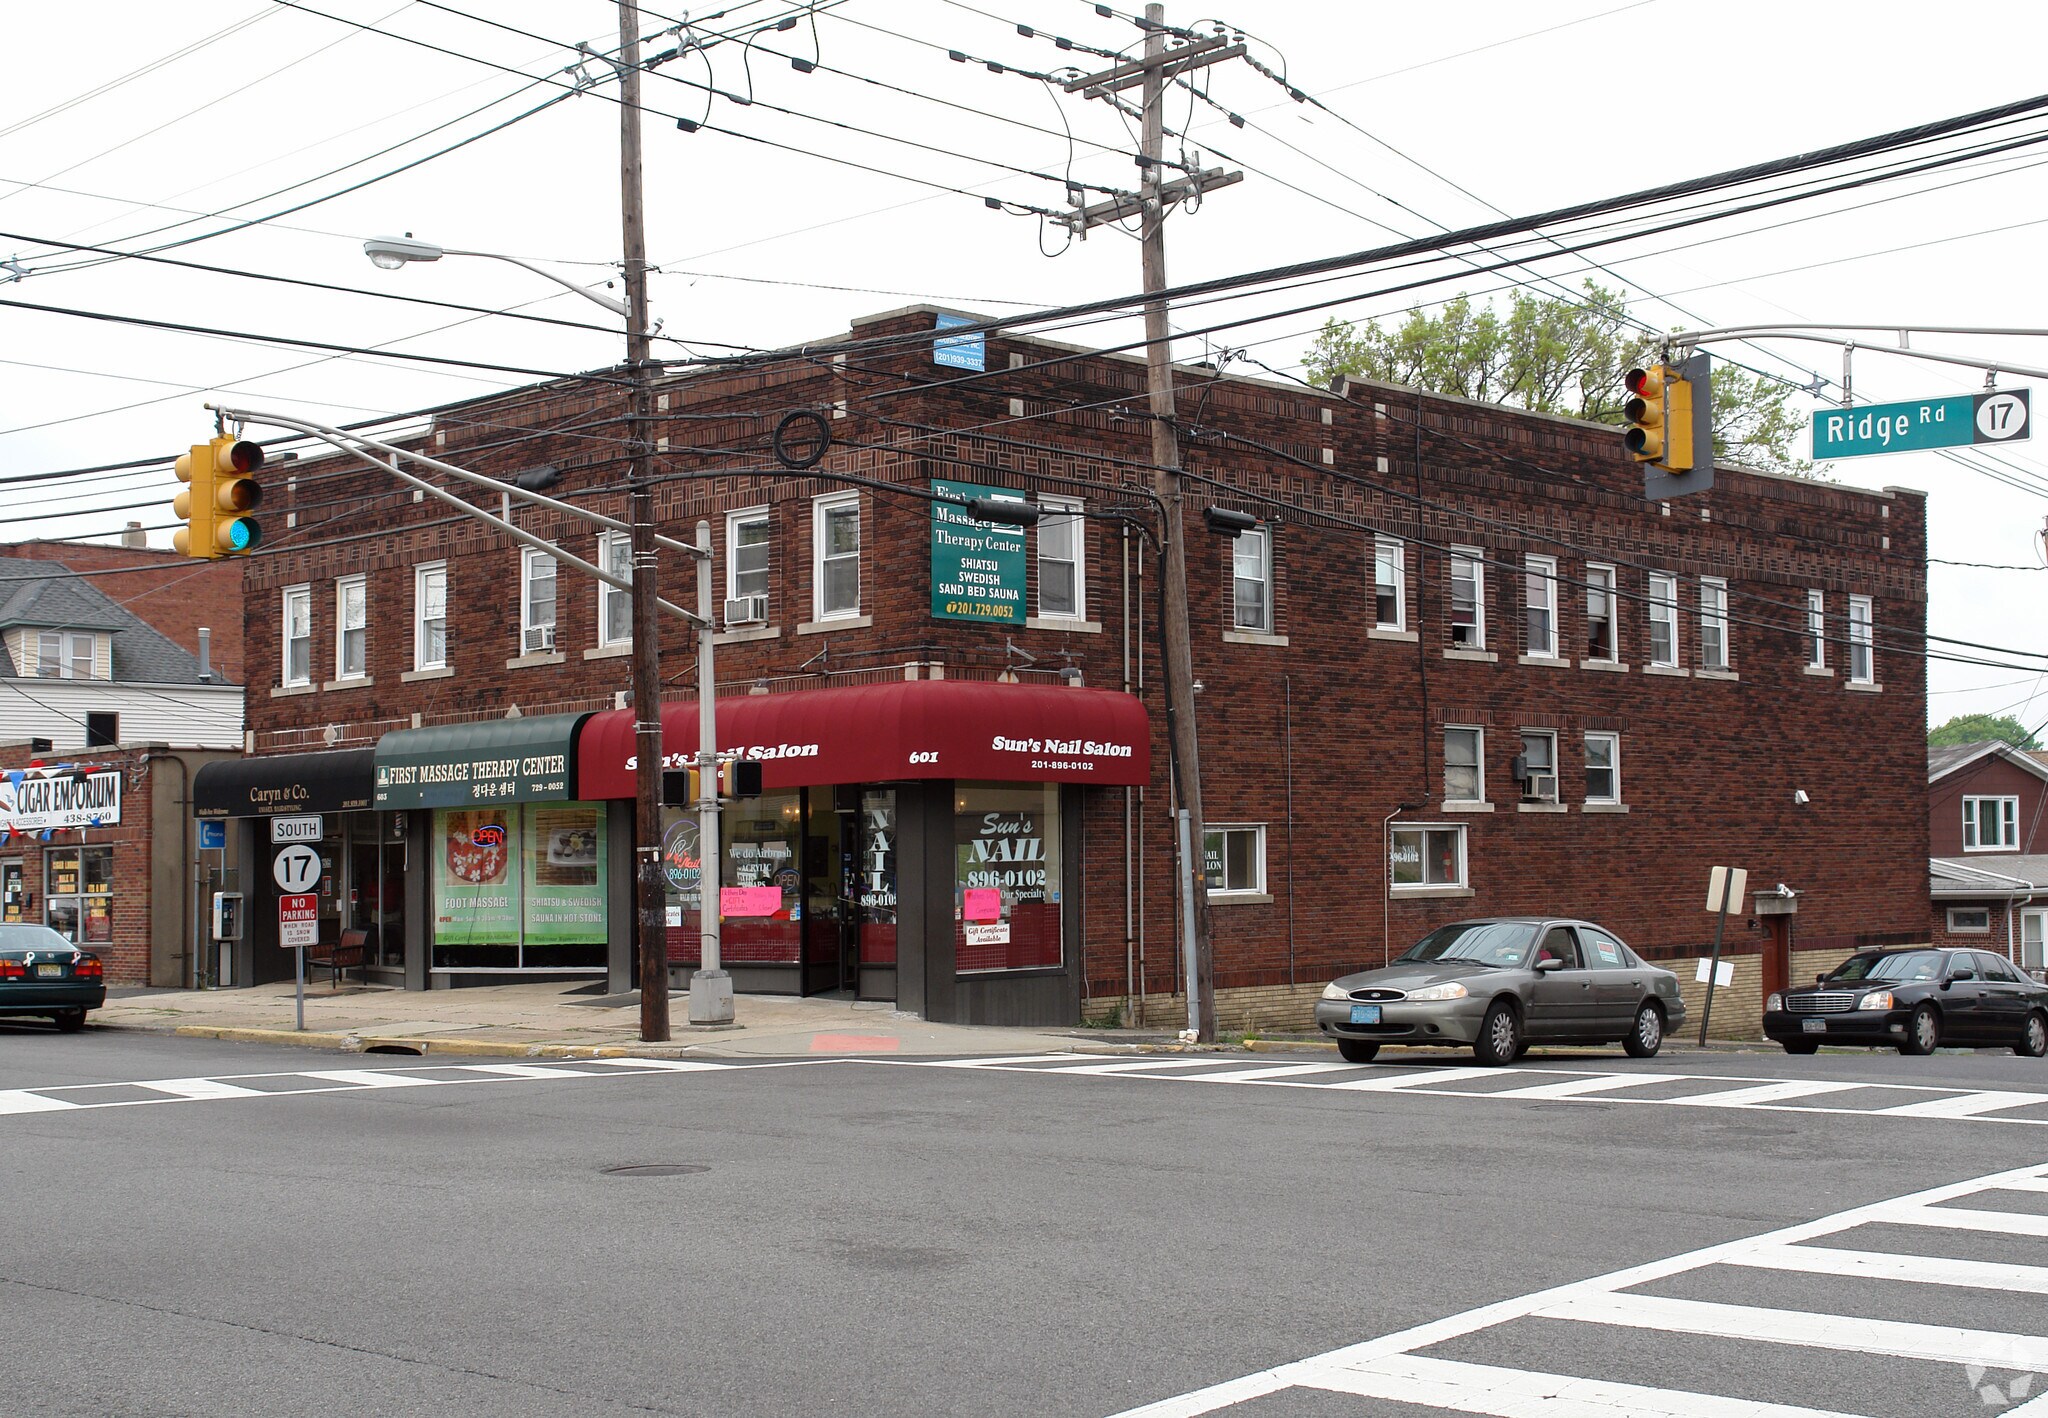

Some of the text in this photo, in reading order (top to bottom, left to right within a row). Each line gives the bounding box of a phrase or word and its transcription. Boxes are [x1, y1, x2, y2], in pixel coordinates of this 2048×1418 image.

[935, 352, 982, 367] (201)939-3337
[1989, 402, 2014, 431] 17
[1828, 404, 1945, 446] Ridge Rd
[936, 530, 1021, 552] Therapy Center
[961, 558, 998, 571] SHIATSU
[959, 572, 1000, 585] SWEDISH
[939, 583, 1019, 600] SAND BED SAUNA
[957, 602, 1013, 617] 201.729.0052
[992, 736, 1132, 757] Sun's Nail Salon
[625, 753, 689, 770] Sn's
[746, 744, 819, 760] Salon
[909, 751, 938, 764] 601
[389, 755, 565, 785] FIRST MASSAGE THERAPY CENTER
[1031, 760, 1094, 770] 201-896-0102
[18, 775, 116, 814] CIGAR EMPORIUM
[250, 784, 310, 805] Caryn & Co.
[277, 823, 317, 836] SOUTH
[980, 812, 1033, 834] Sun's
[472, 829, 502, 843] OPEN
[729, 847, 792, 858] We do Airbrush
[868, 809, 891, 892] NAIL
[966, 838, 1047, 863] NAIL
[283, 855, 311, 882] 17
[742, 864, 771, 872] ACRYLIC
[1206, 861, 1222, 870] LON
[669, 868, 701, 879] 896-0102
[967, 869, 1046, 888] 896-0102
[774, 874, 800, 887] OPEN
[1000, 890, 1013, 899] Our
[1015, 889, 1046, 901] Specialty
[292, 898, 306, 908] NO
[445, 897, 508, 909] FOOT MASSAGE
[531, 897, 560, 907] SHIATSU
[568, 897, 602, 907] SWEDISH
[283, 909, 315, 920] PARKING
[531, 913, 602, 923] SAUNA IN HOT STONE
[968, 926, 1008, 936] Gift Certificate
[976, 935, 1001, 943] Available
